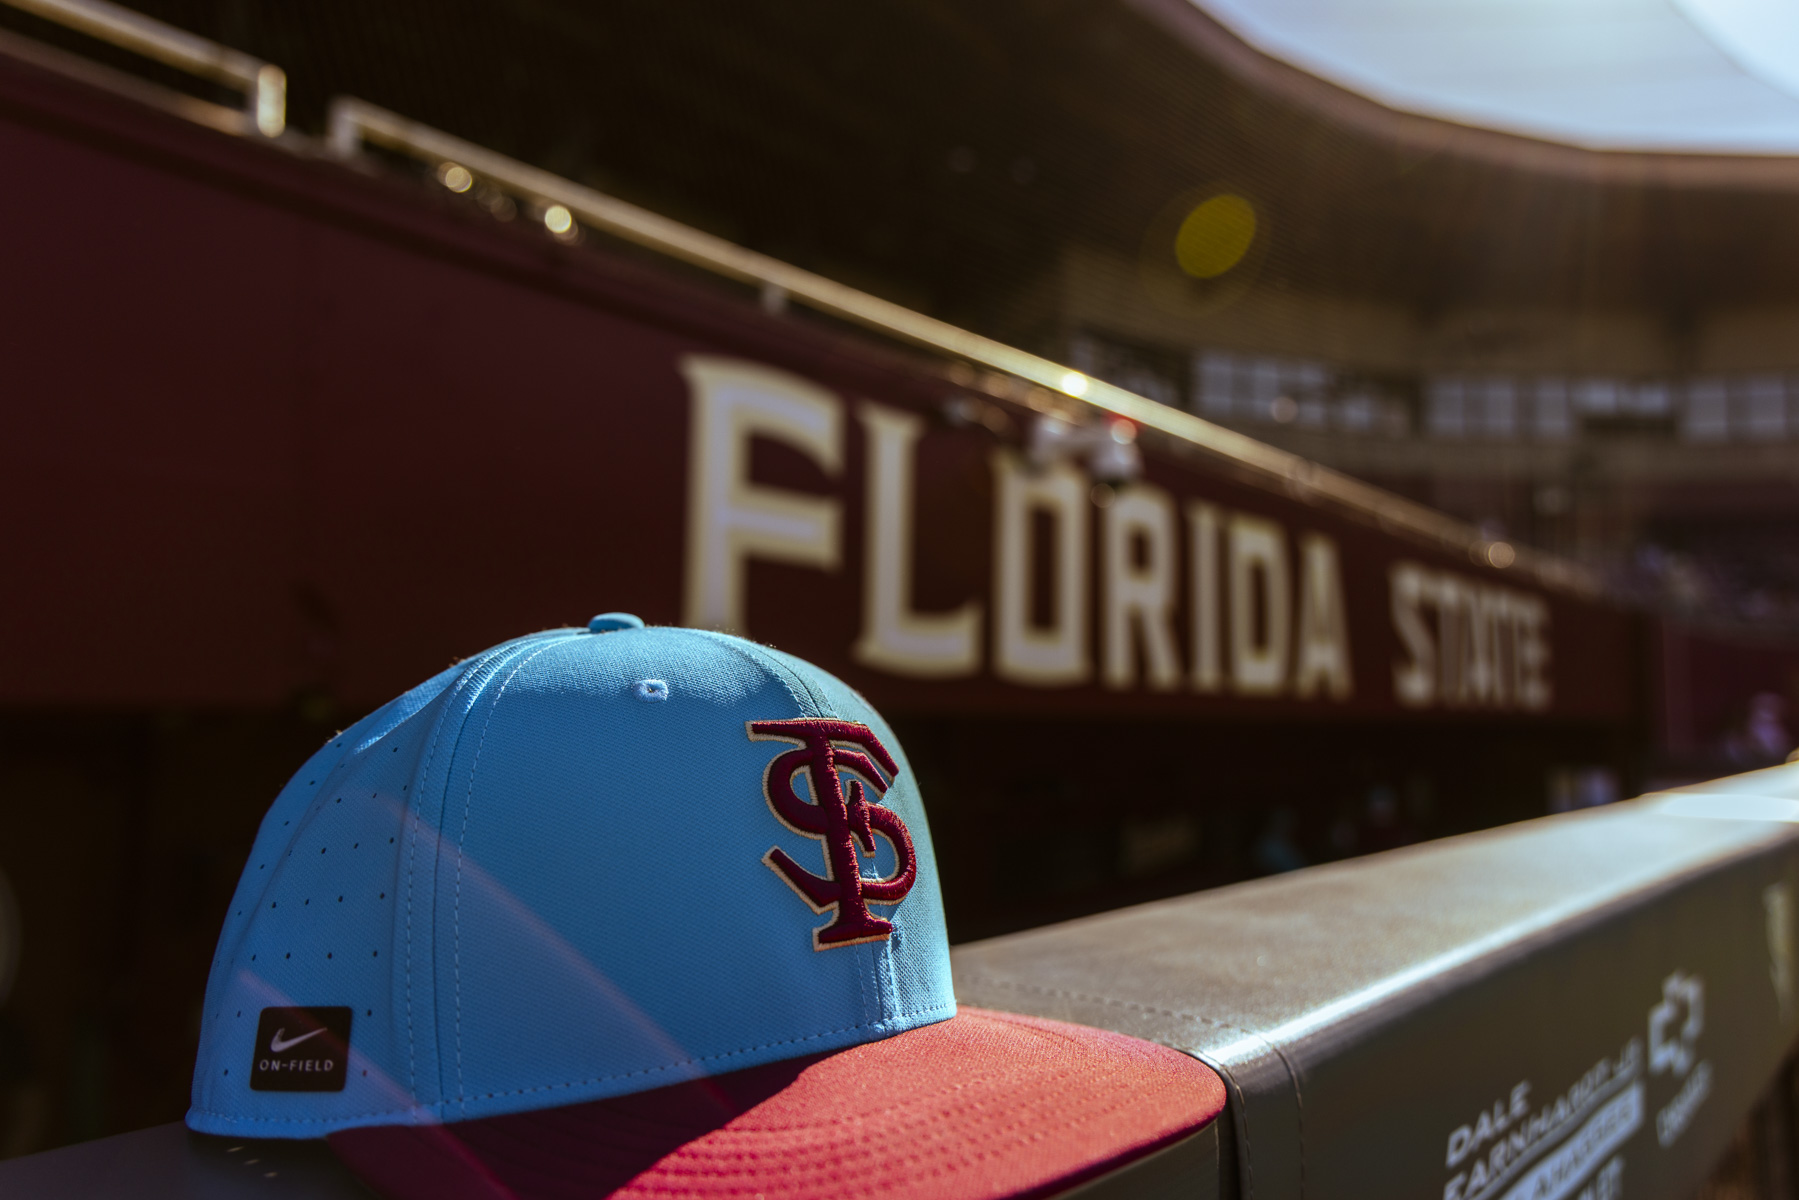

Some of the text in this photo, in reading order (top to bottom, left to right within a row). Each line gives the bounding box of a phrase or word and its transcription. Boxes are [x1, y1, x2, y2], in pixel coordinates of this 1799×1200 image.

[681, 354, 1552, 709] FLORIDA STATE
[259, 1059, 334, 1072] ON-FIELD
[1445, 1079, 1531, 1170] DALE
